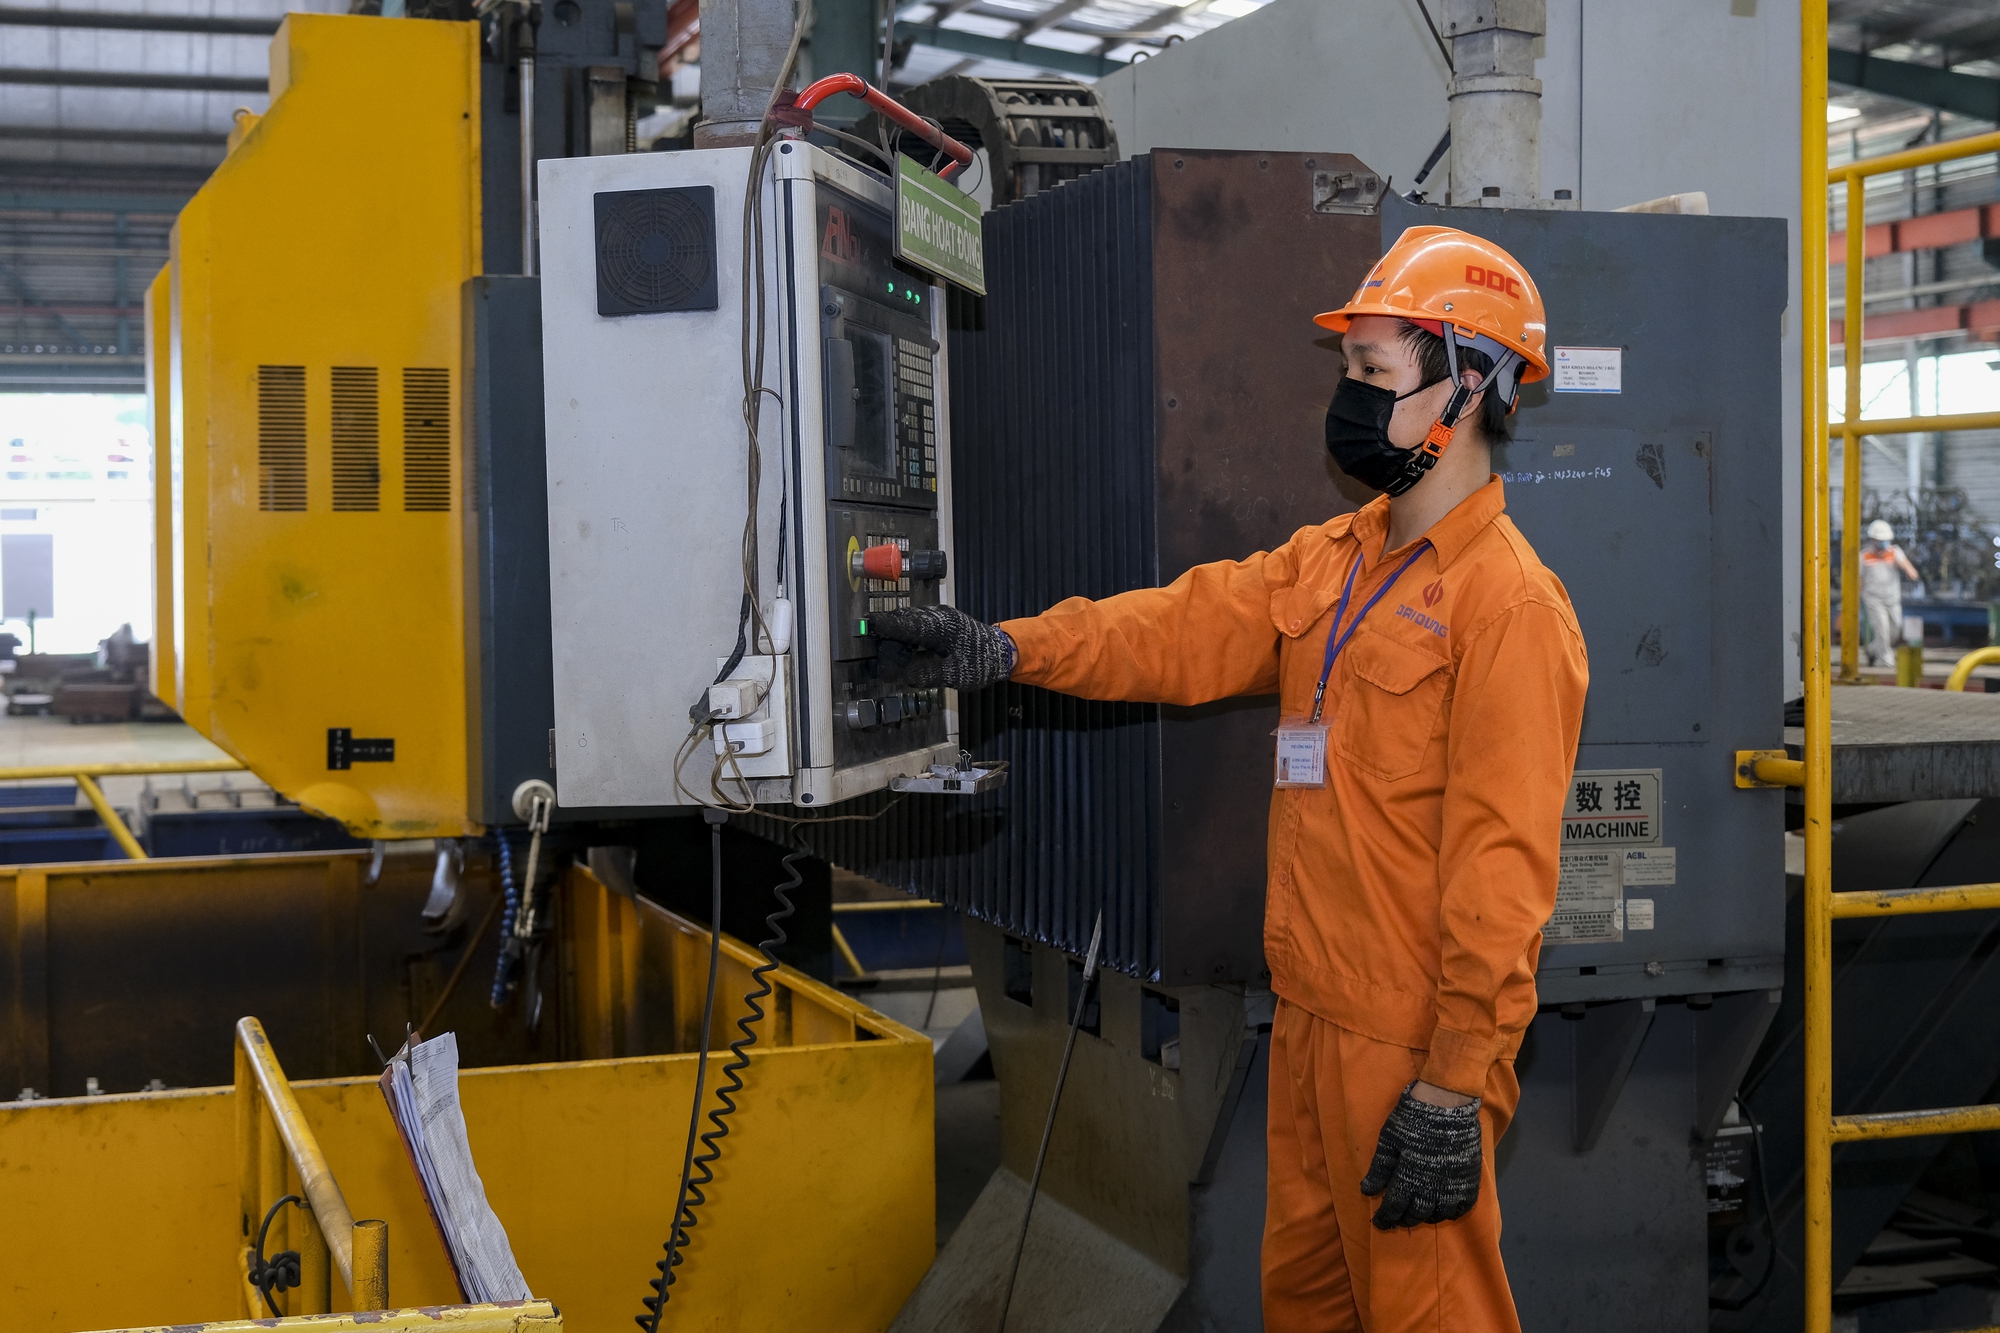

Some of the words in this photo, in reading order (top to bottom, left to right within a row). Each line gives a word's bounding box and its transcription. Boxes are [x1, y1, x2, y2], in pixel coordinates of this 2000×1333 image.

[902, 195, 931, 244] ĐANG
[932, 211, 956, 263] HOẠT
[1465, 264, 1520, 301] DDC
[1575, 780, 1642, 813] 数控
[1566, 821, 1649, 840] MACHINE
[1626, 851, 1647, 860] ACBL
